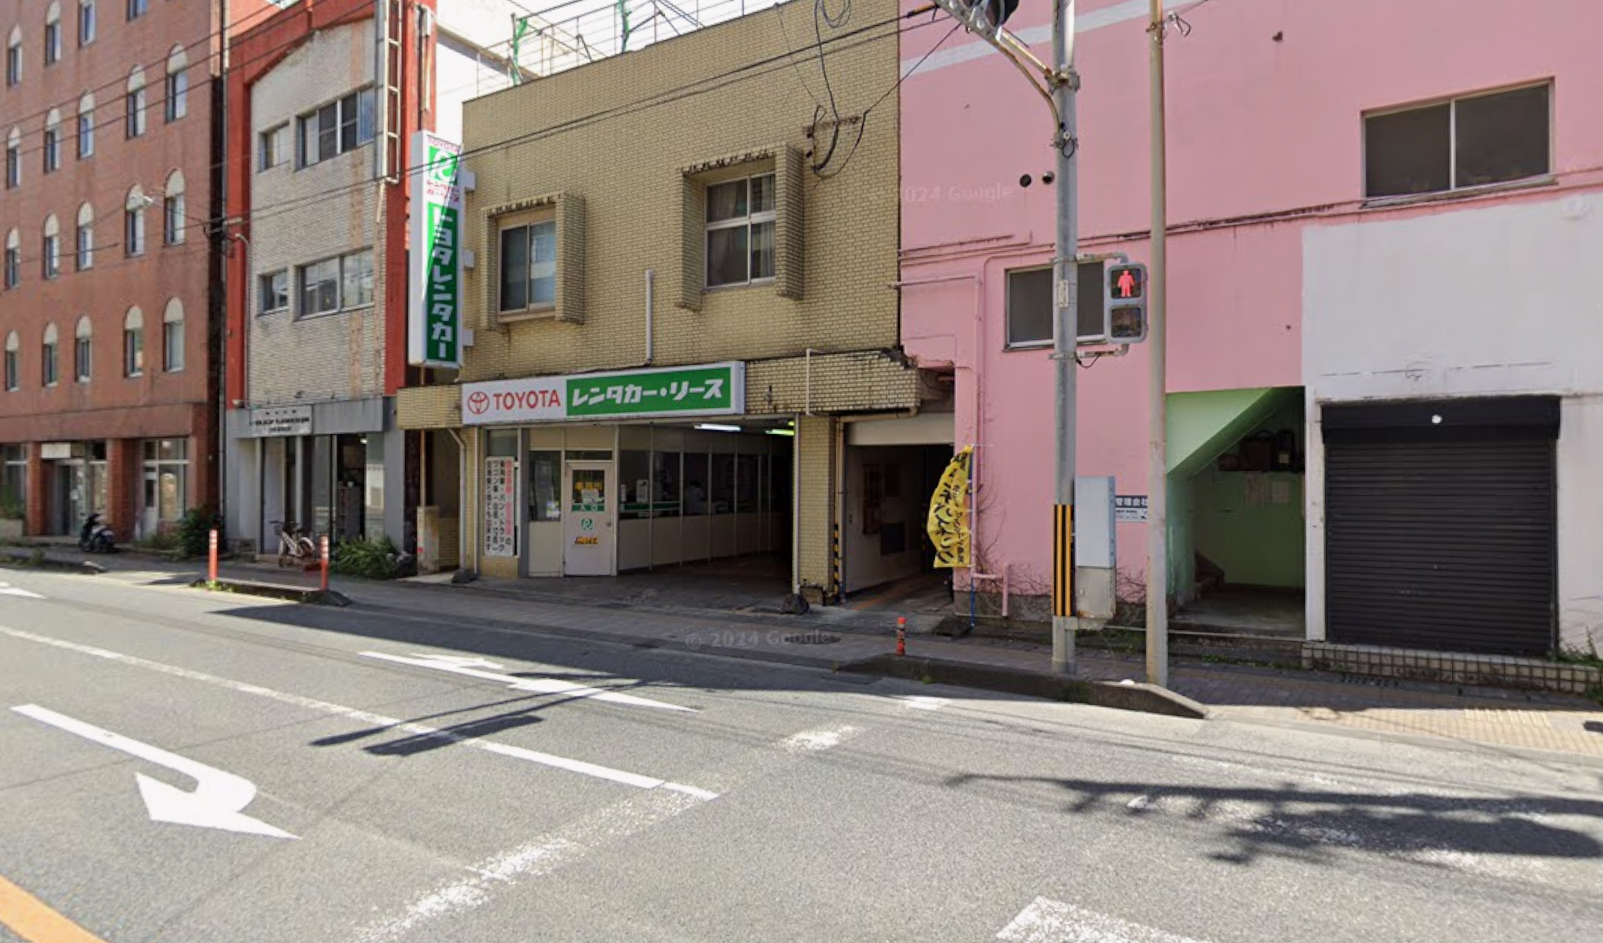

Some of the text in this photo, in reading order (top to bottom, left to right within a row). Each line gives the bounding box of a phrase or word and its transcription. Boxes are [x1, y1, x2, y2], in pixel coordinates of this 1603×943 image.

[432, 206, 453, 358] トヨタレンタカー
[493, 389, 561, 411] TOYOTA
[572, 378, 724, 407] レンタカー・リース
